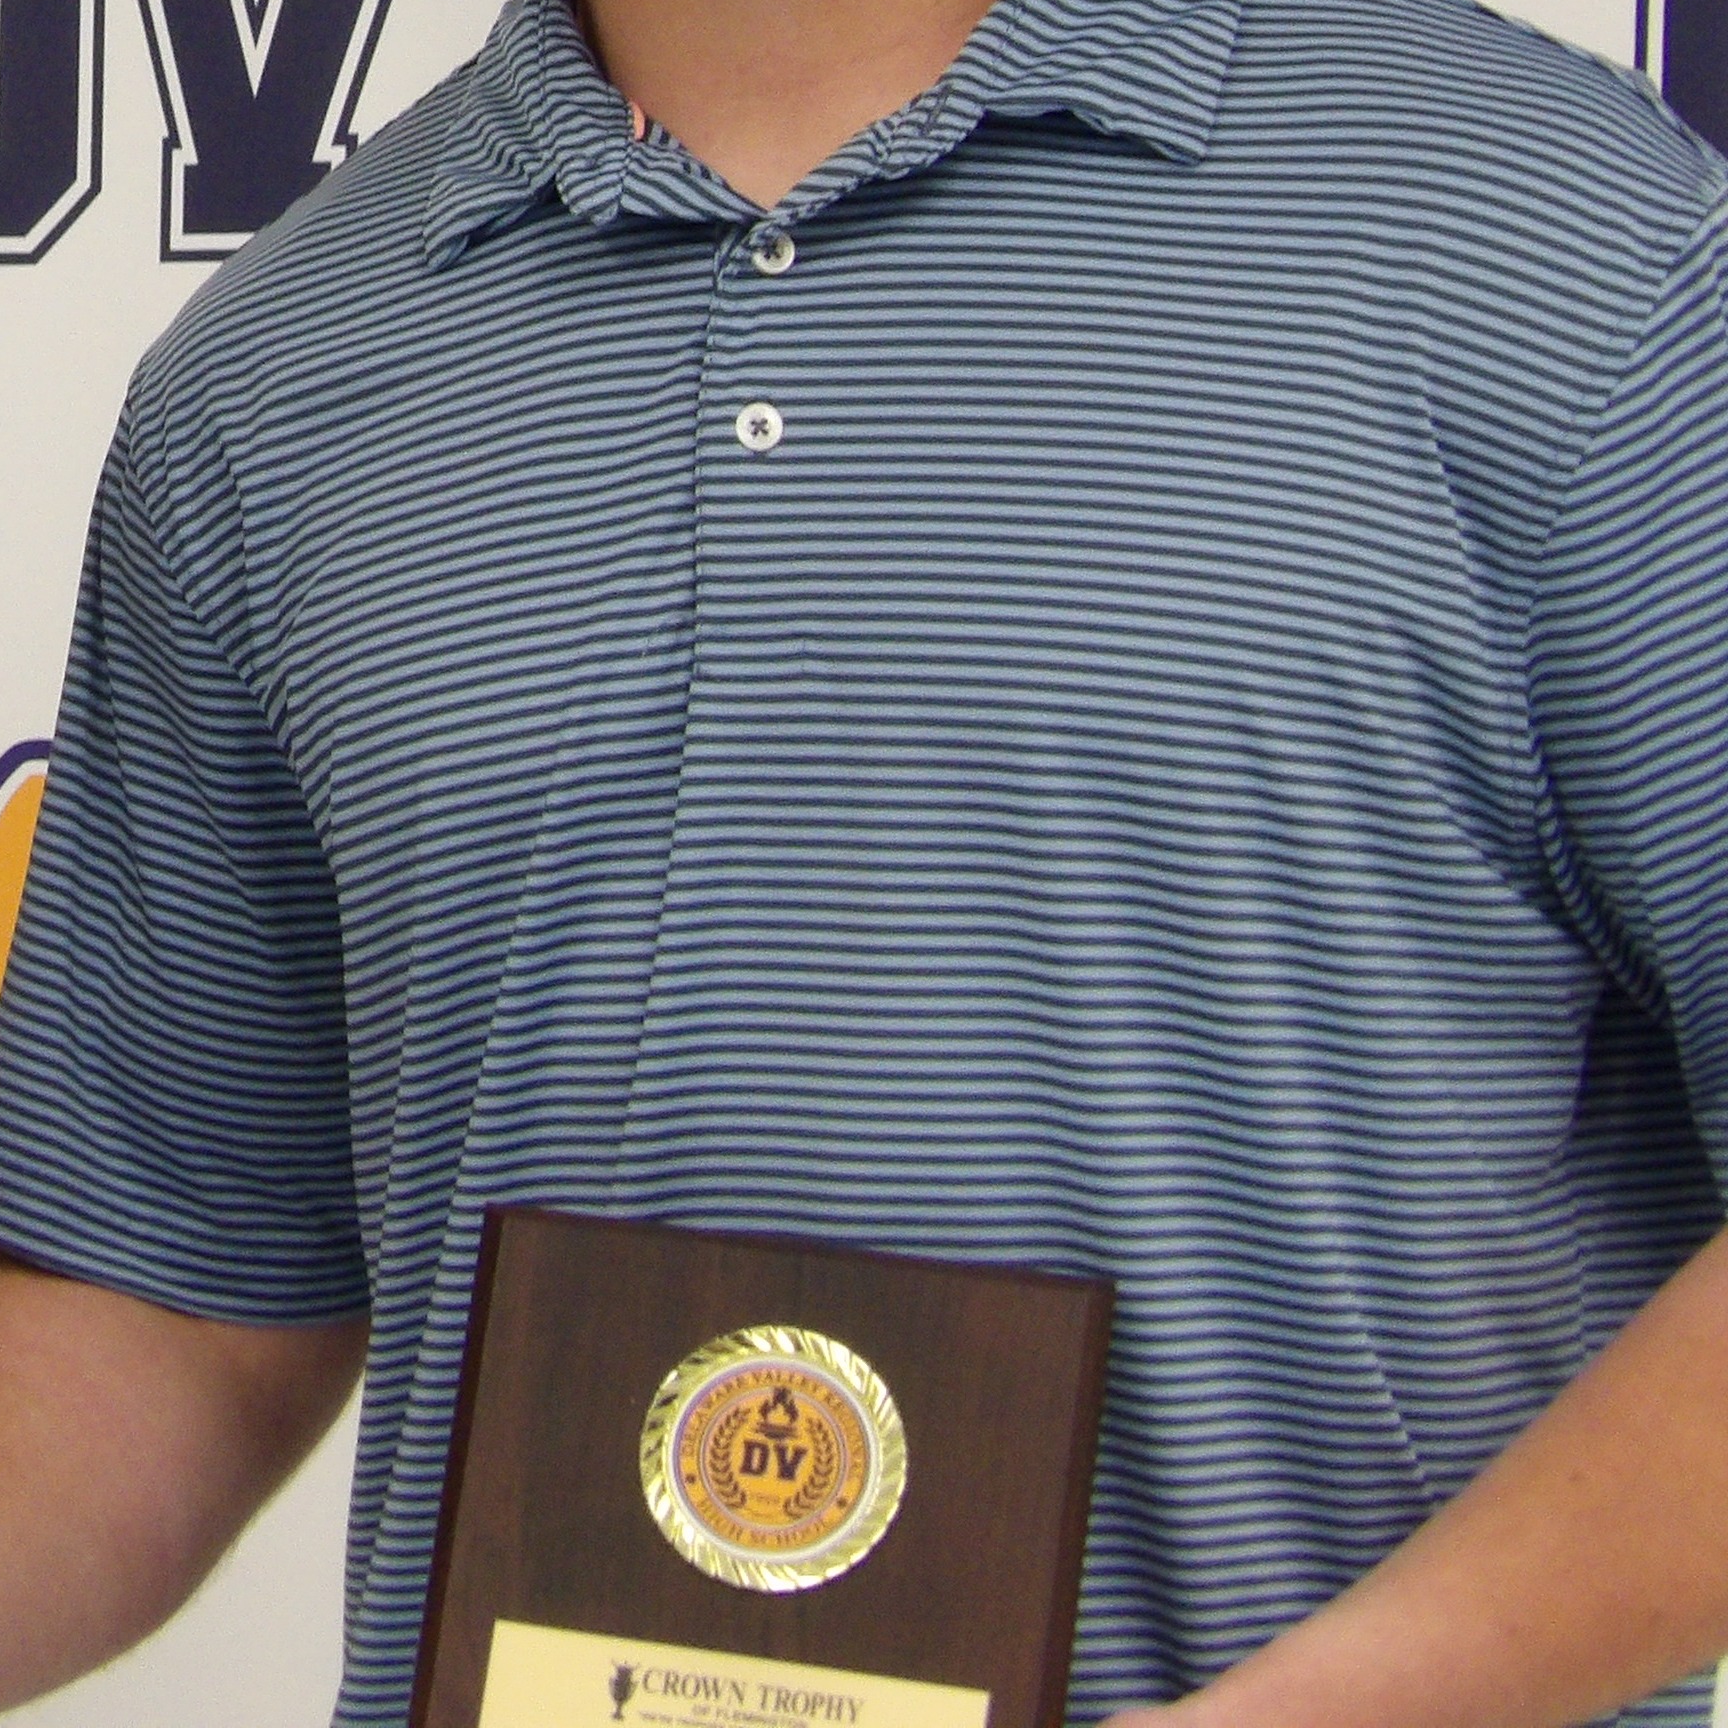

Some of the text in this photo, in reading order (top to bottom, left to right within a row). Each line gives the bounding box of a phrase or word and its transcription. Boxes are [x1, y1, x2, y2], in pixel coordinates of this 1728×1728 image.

[739, 1439, 809, 1481] DV
[642, 1669, 747, 1705] CROWN
[757, 1683, 865, 1724] TROPHY
